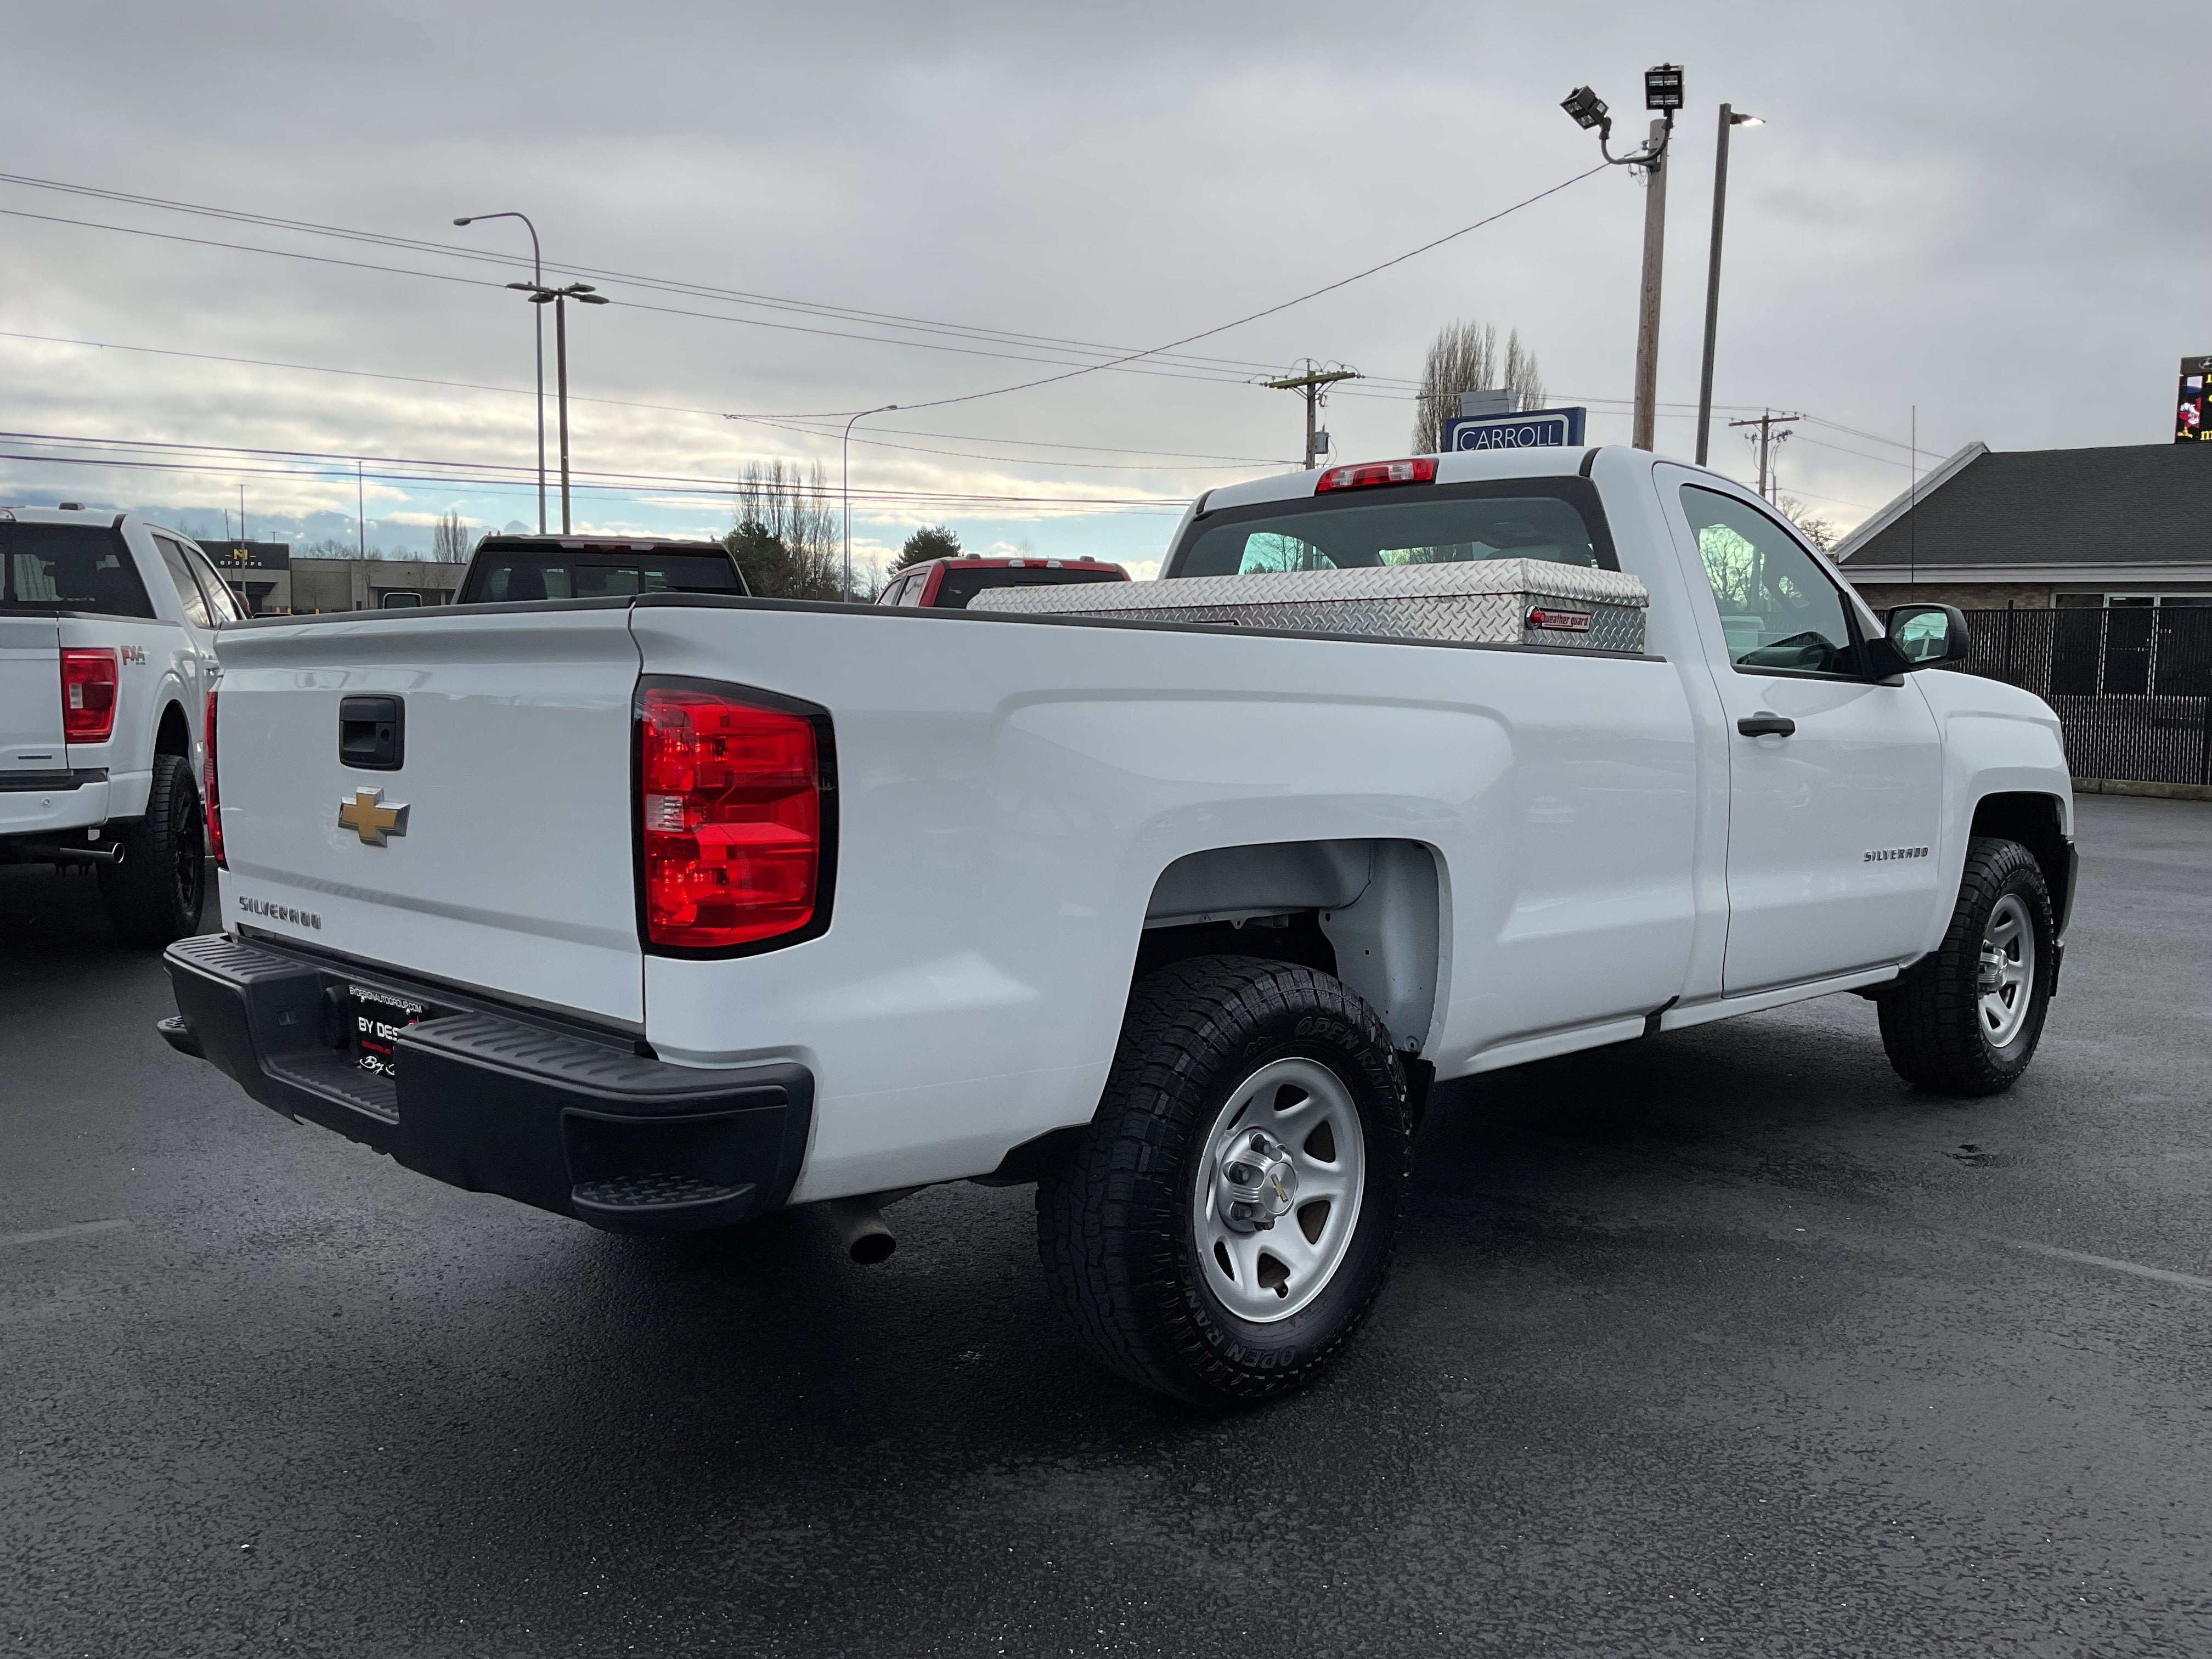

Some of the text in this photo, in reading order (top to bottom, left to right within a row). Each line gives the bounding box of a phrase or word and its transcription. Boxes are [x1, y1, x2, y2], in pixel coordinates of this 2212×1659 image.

[1460, 425, 1559, 452] CARROLL
[1544, 614, 1589, 627] weather guard
[1863, 847, 1928, 862] SILVERADO
[239, 895, 321, 930] SILVERADO
[349, 986, 422, 1013] BYDESIGNAUTOGROUP.COM
[358, 1016, 400, 1041] BY DES
[1294, 1015, 1359, 1050] OPEN
[1223, 1341, 1295, 1369] OPEN
